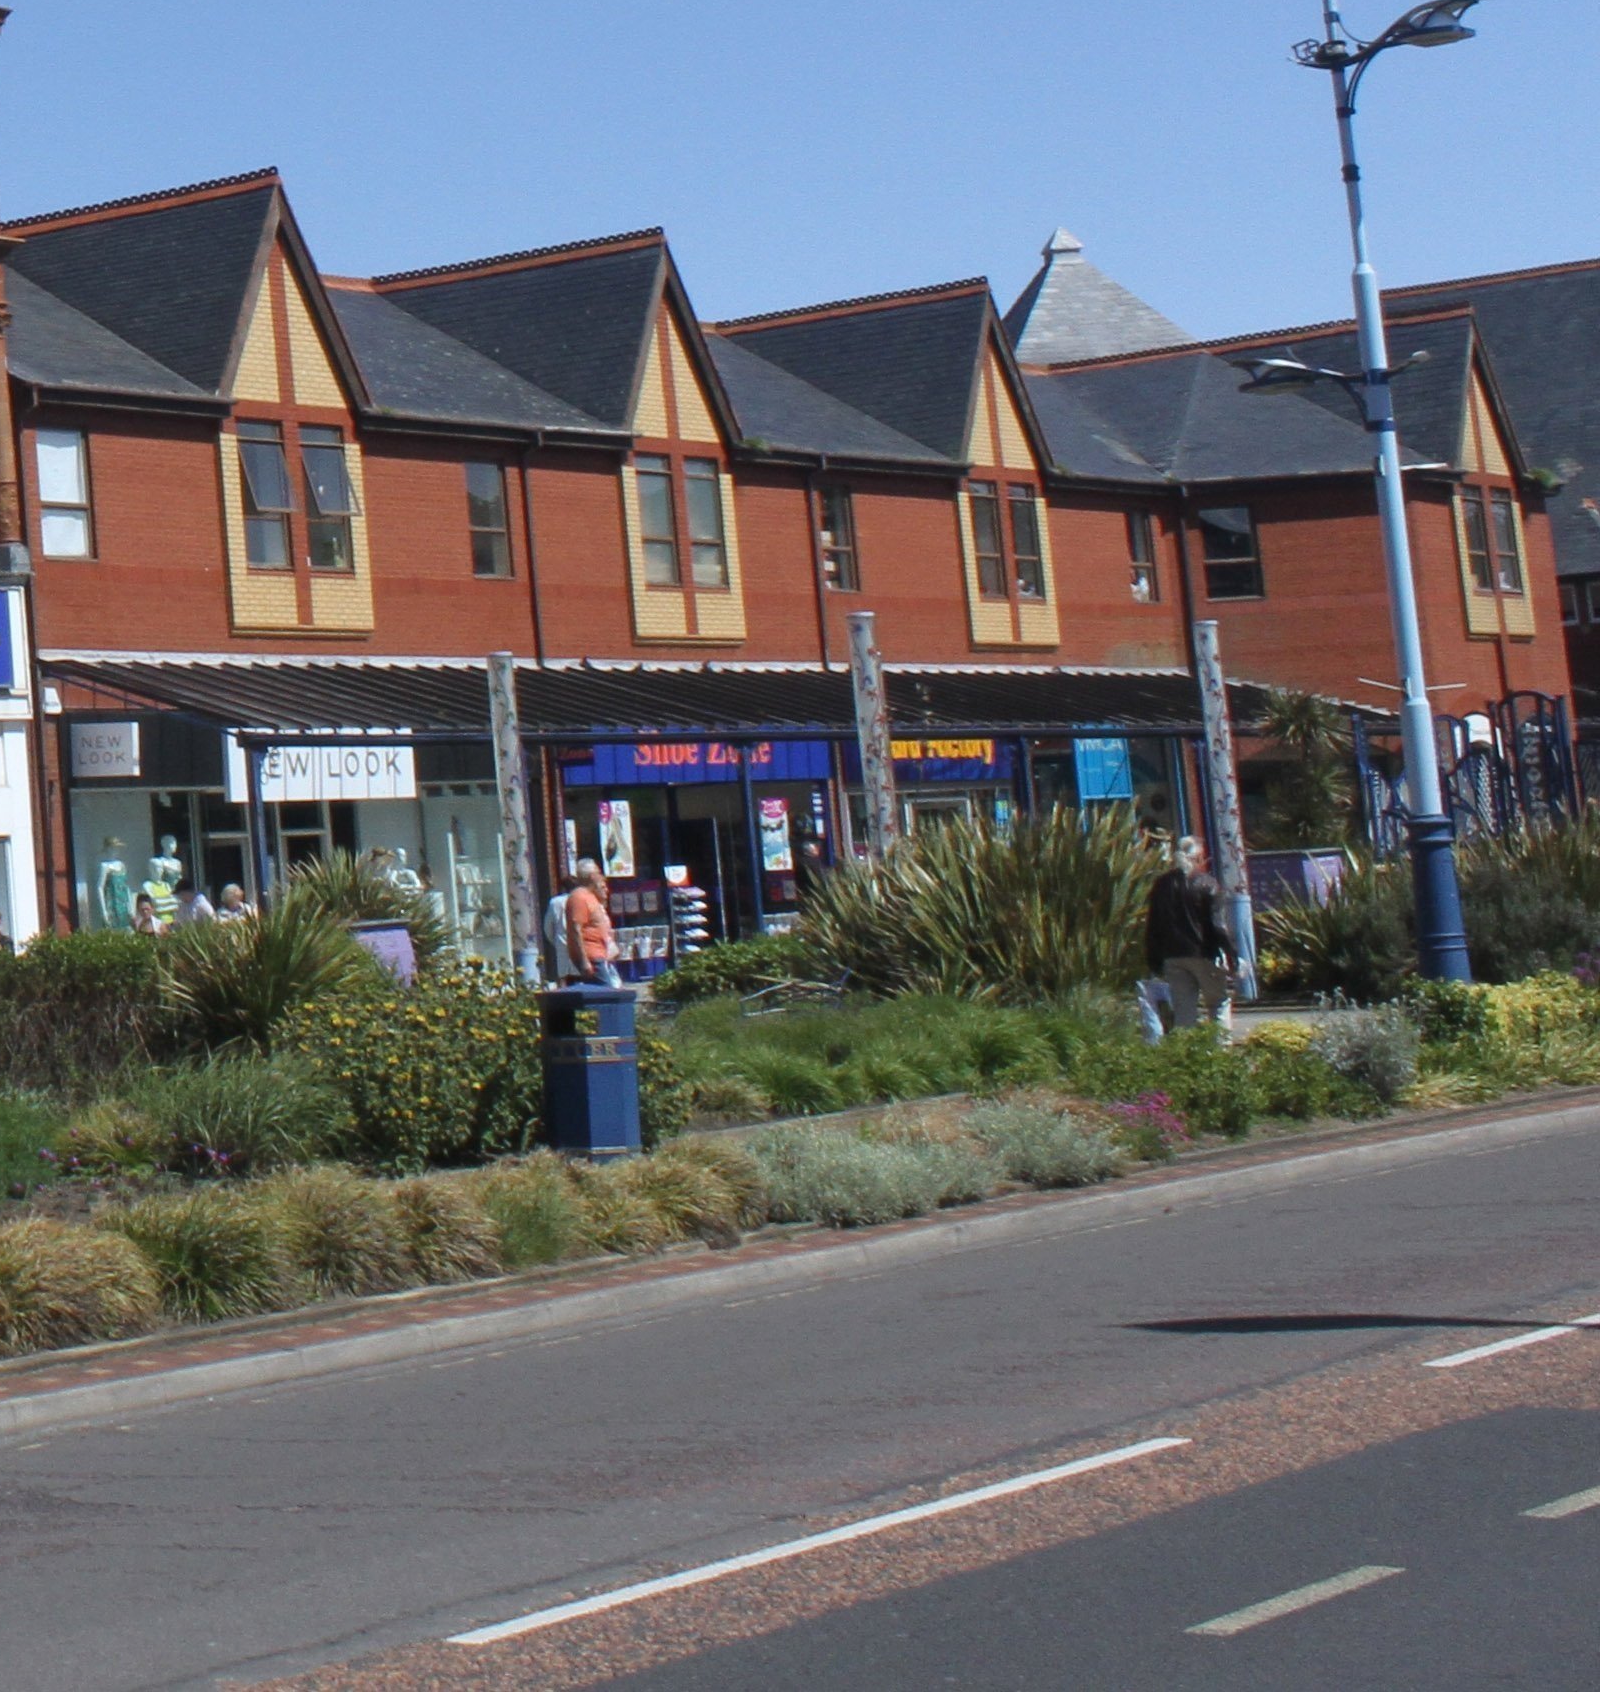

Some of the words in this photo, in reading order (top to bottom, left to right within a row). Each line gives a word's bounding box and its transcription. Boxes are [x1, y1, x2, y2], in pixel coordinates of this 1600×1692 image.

[81, 735, 122, 748] NEW
[78, 751, 127, 765] LOOK
[266, 750, 311, 778] EW
[326, 750, 402, 778] LOOK
